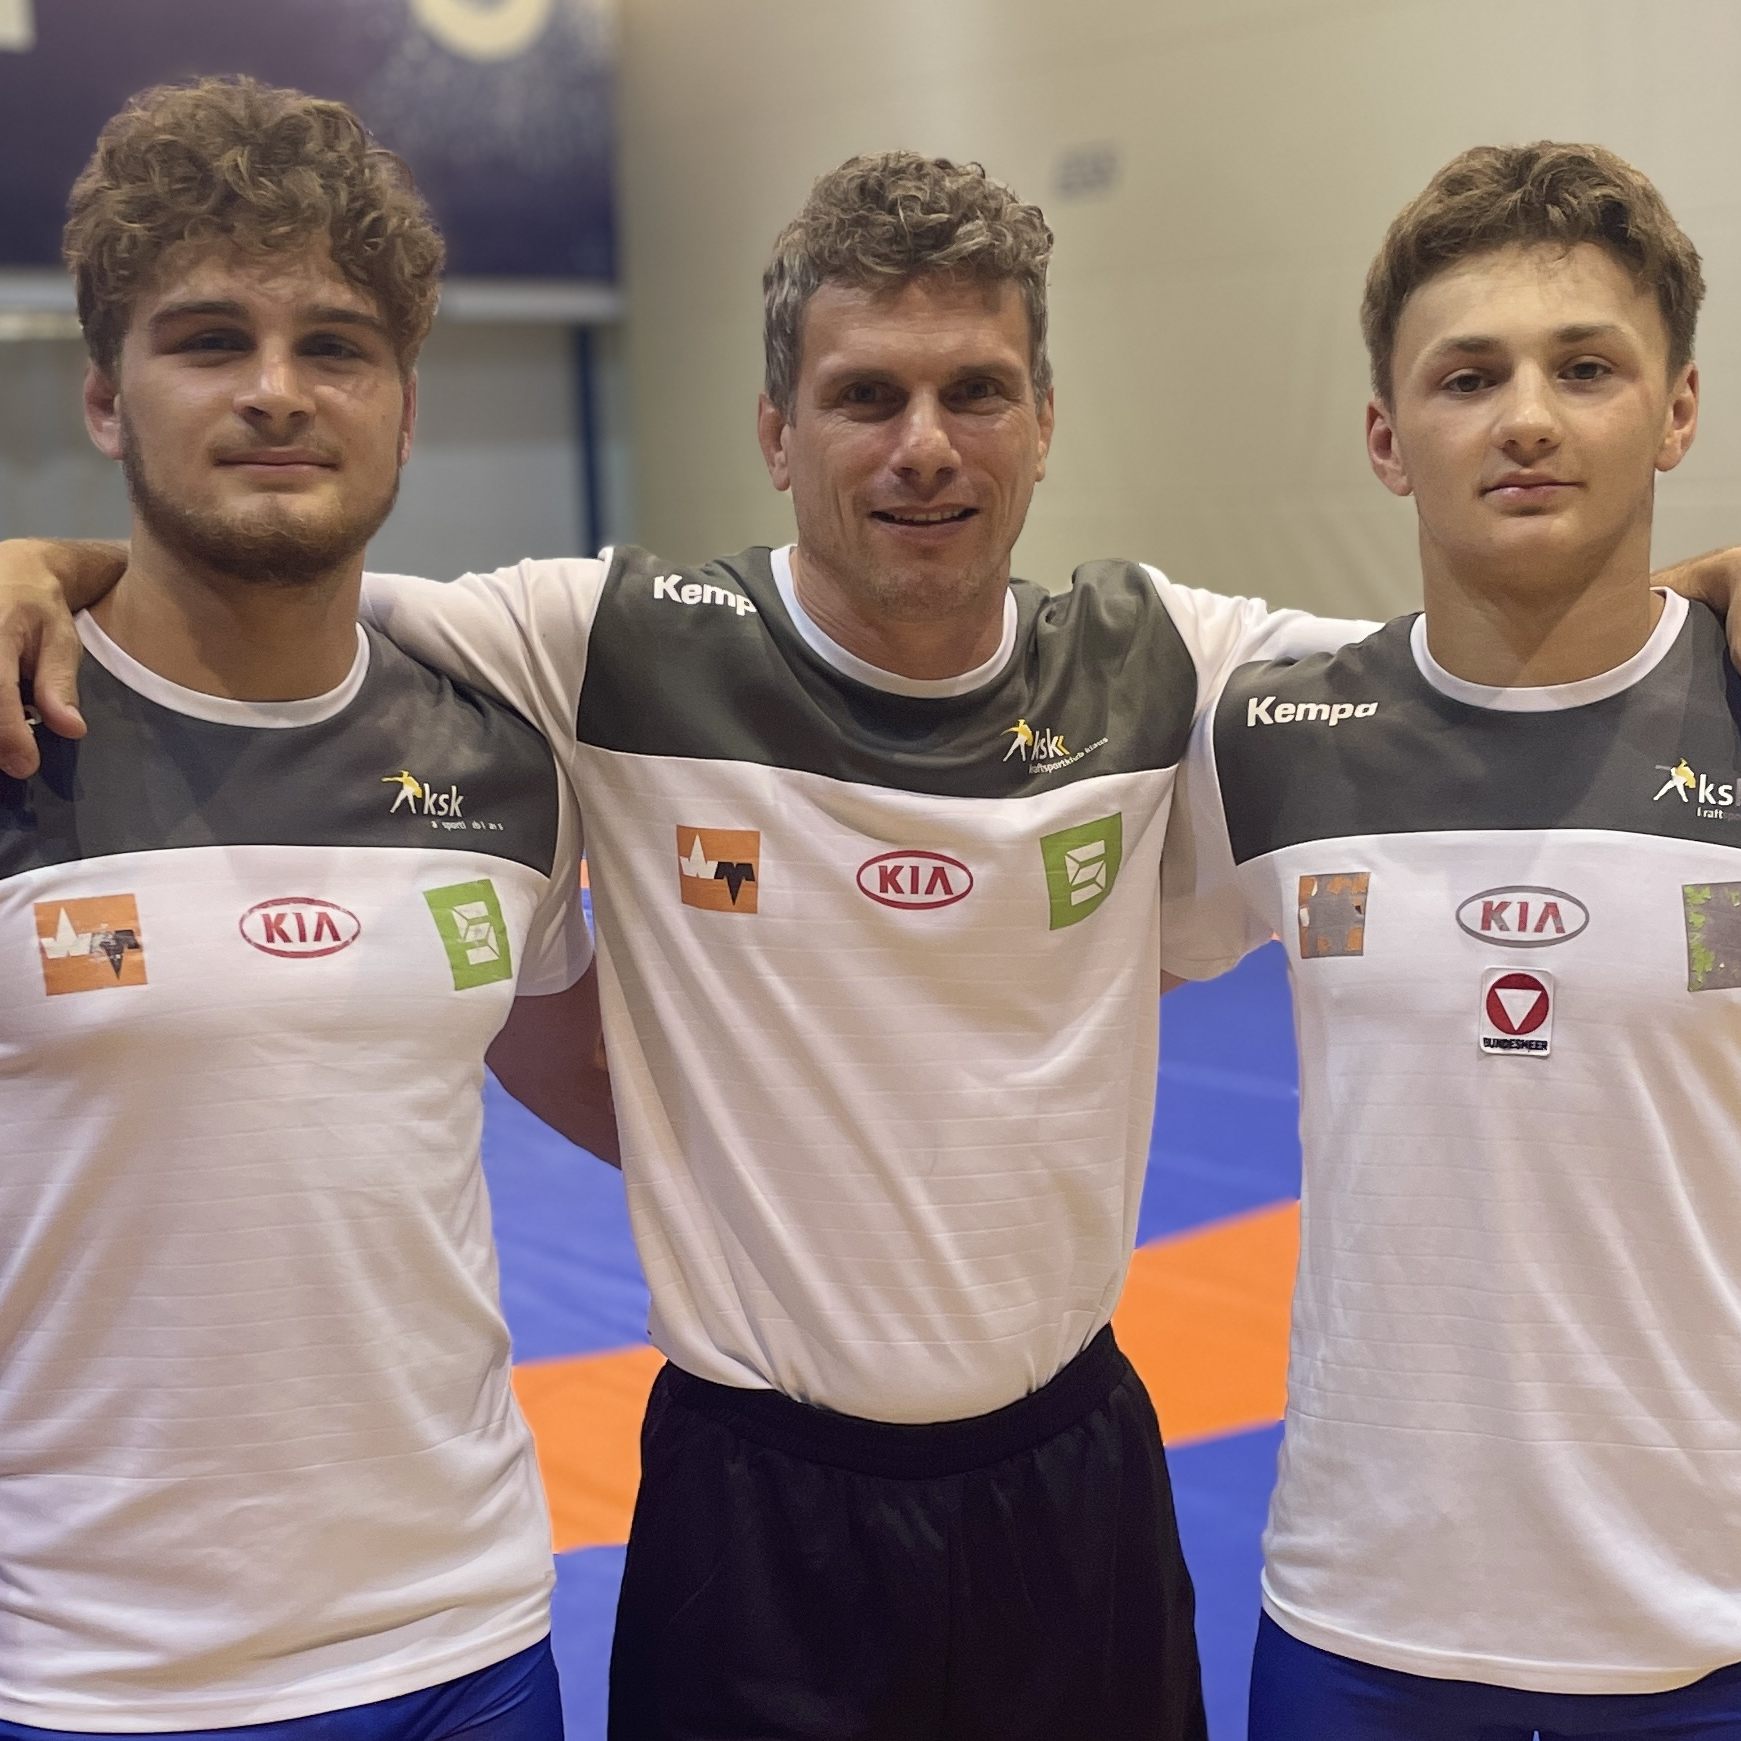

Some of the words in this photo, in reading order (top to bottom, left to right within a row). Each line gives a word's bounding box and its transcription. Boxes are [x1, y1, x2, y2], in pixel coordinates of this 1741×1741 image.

[653, 573, 757, 616] Kemp
[1247, 696, 1379, 727] Kempa
[423, 783, 464, 818] ksk
[878, 865, 954, 895] KIA
[261, 912, 342, 943] KIA
[1481, 900, 1566, 934] KIA
